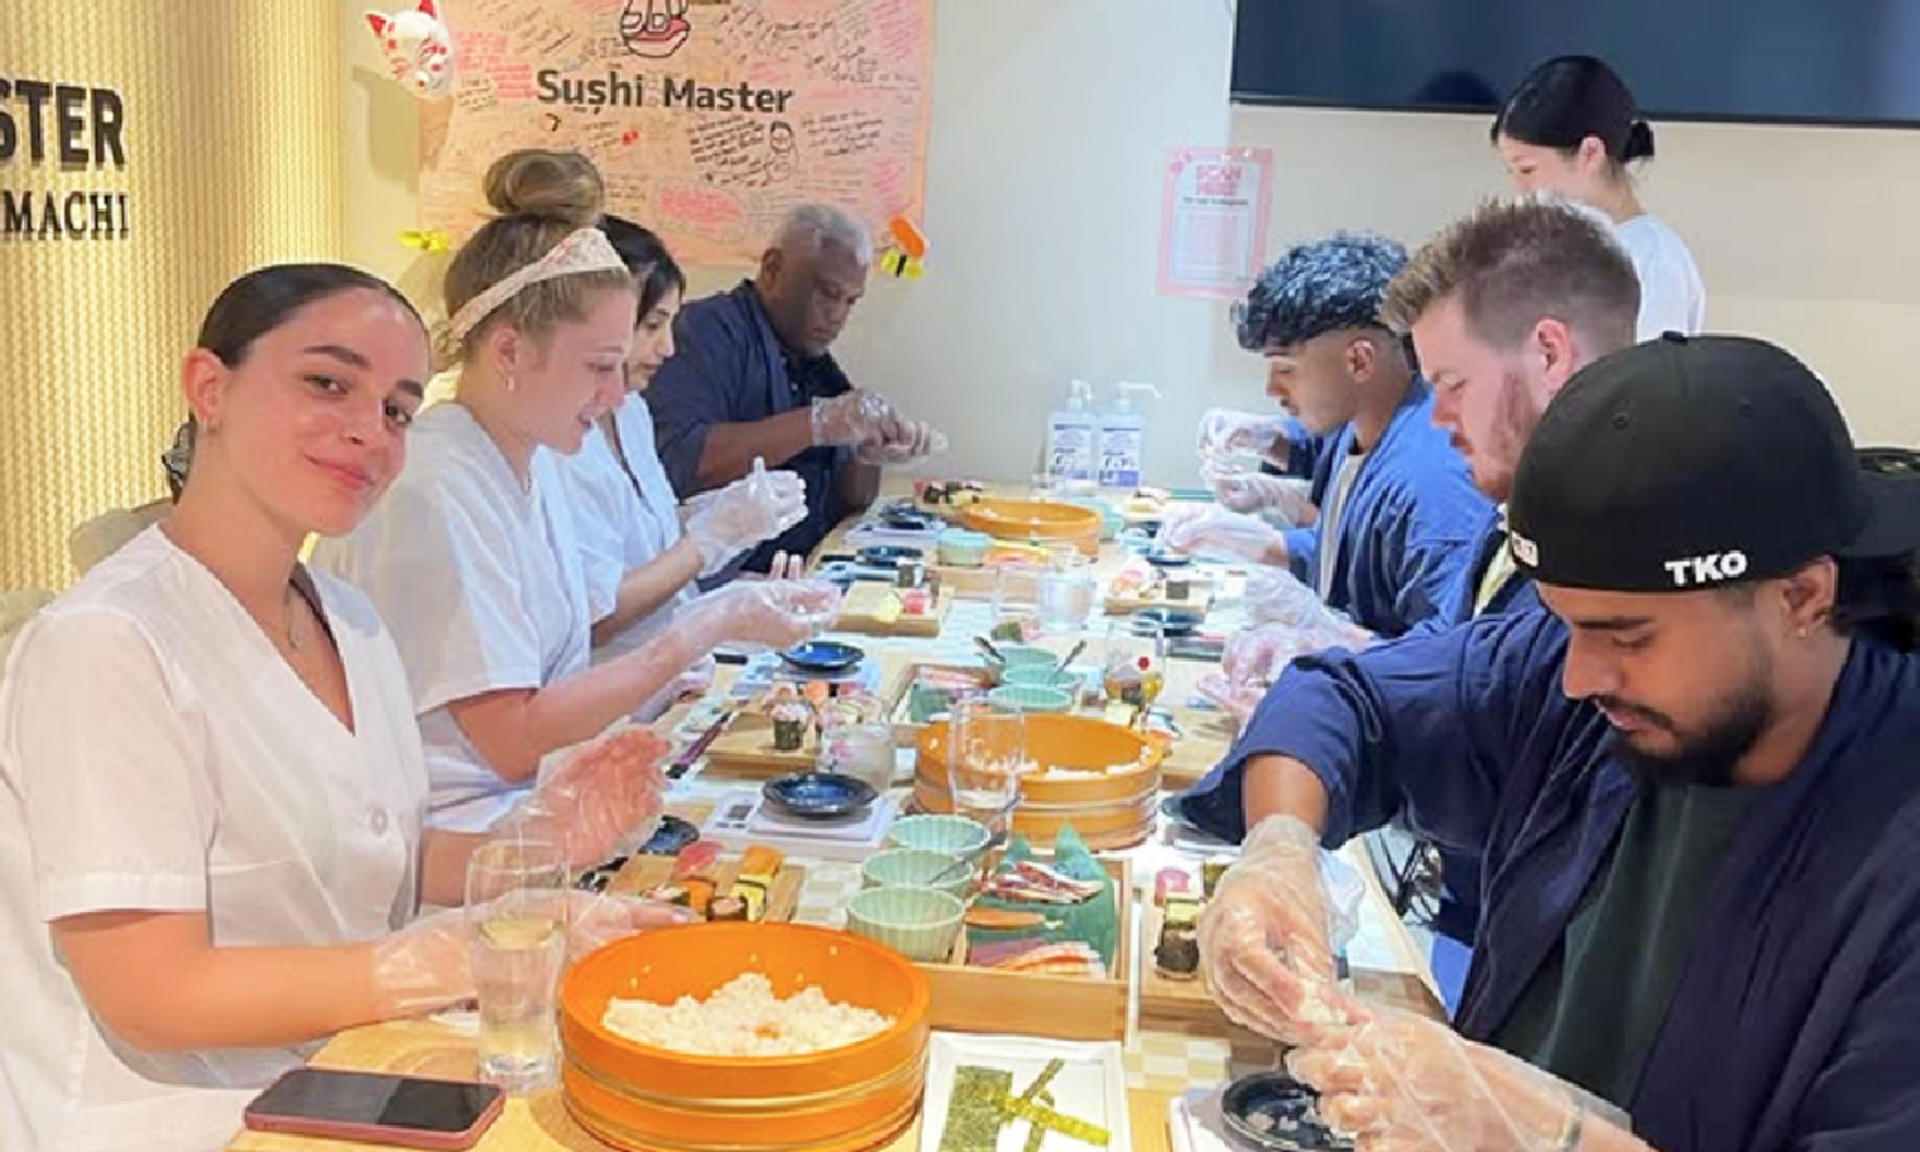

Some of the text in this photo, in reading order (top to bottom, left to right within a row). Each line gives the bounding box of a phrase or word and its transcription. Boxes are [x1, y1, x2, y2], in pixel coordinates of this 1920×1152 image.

[537, 69, 643, 107] Sushi
[663, 78, 794, 113] Master
[3, 189, 130, 234] MACHI
[1664, 549, 1748, 586] TKO
